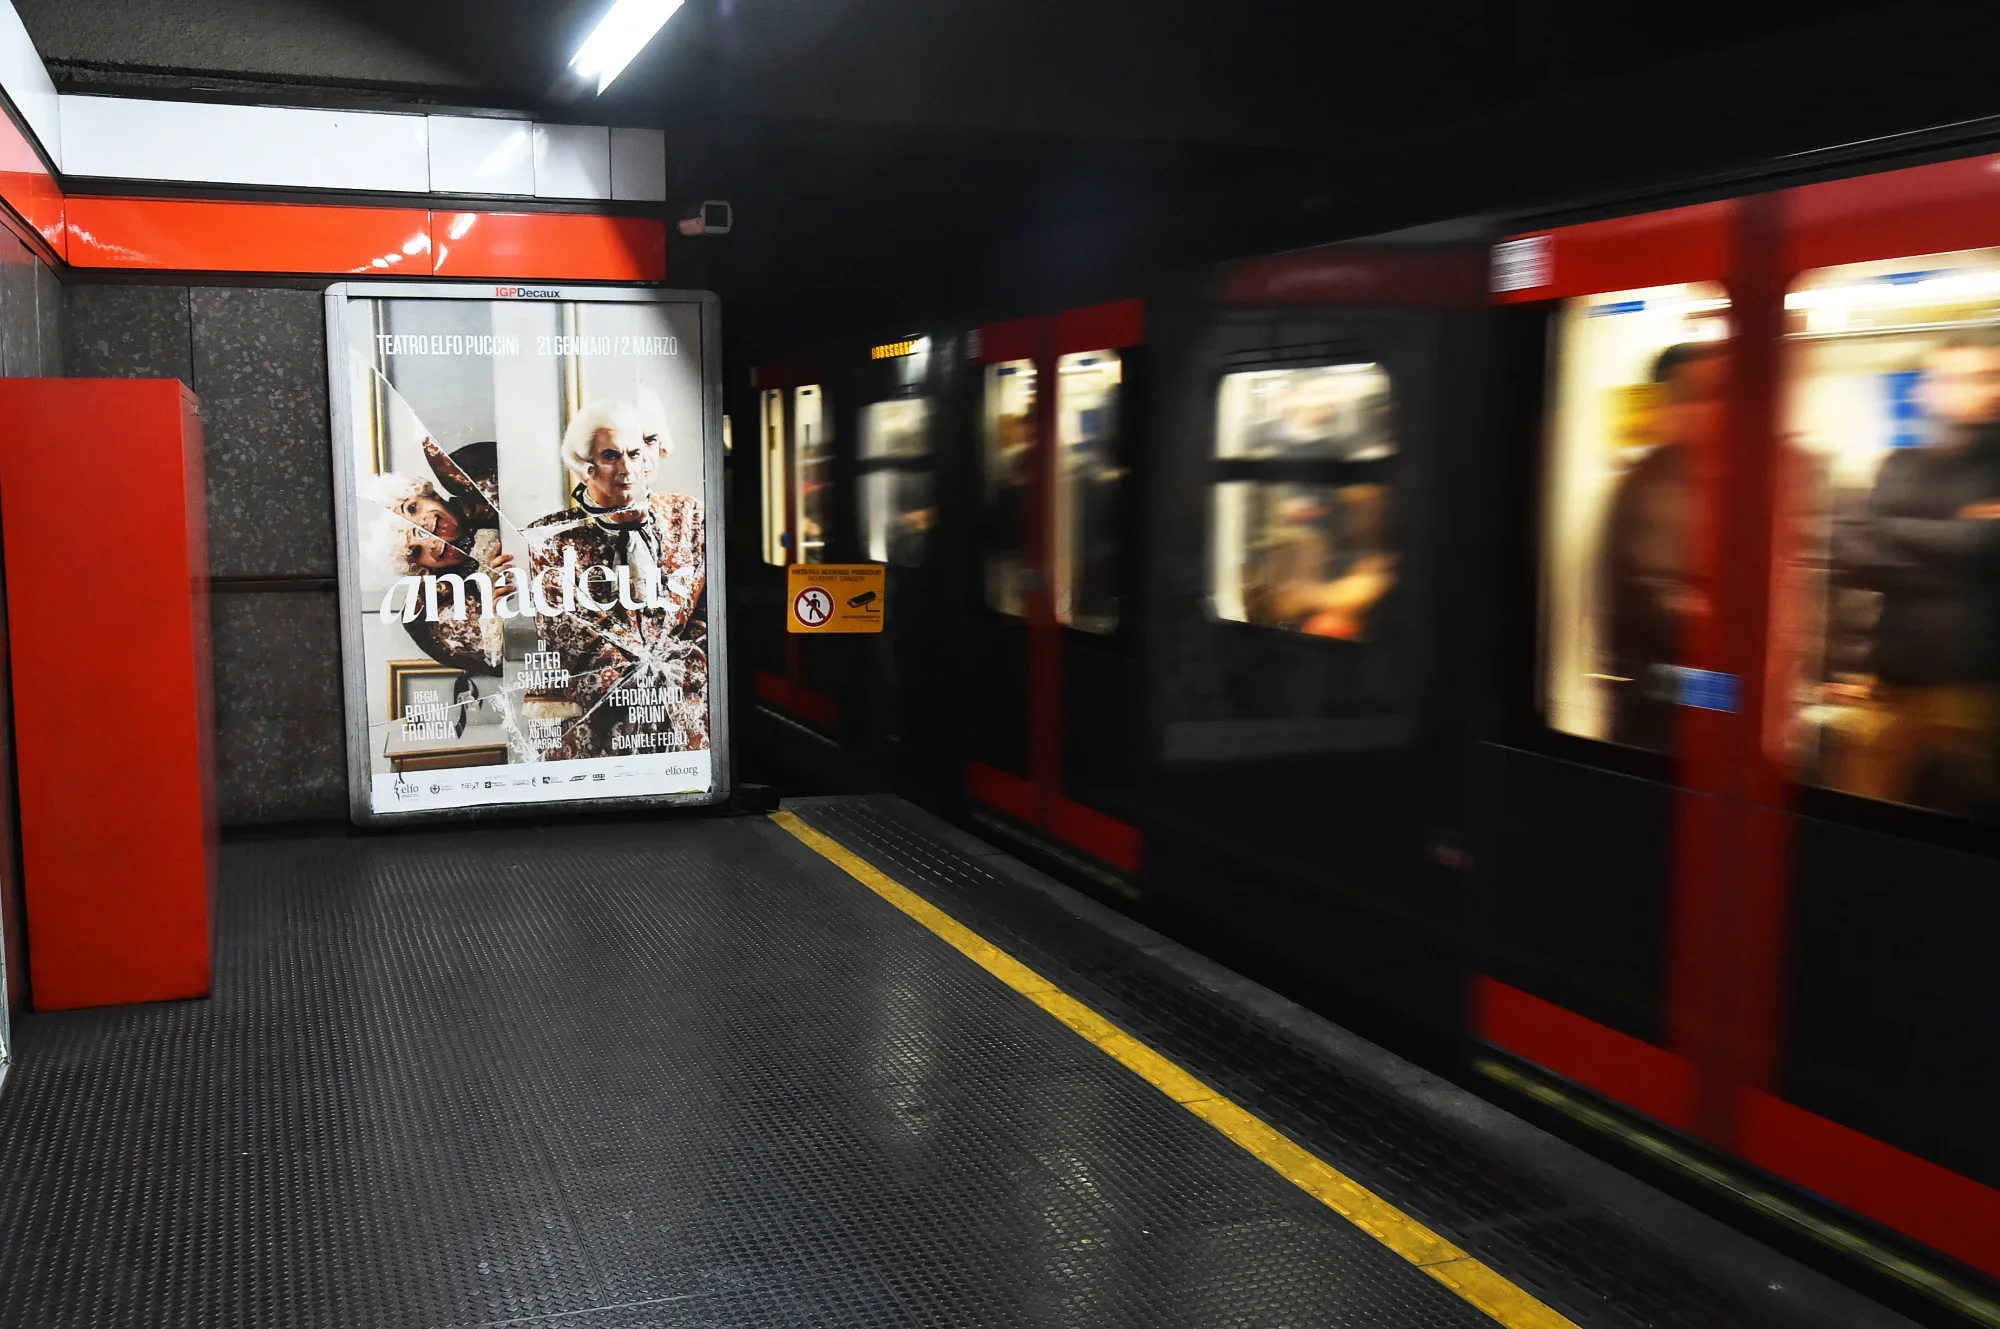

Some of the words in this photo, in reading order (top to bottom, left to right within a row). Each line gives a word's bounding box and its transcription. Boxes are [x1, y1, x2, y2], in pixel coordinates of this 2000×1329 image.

[495, 287, 560, 298] IGPDecaux
[376, 334, 428, 355] TEATRO
[430, 334, 463, 355] ELFO
[466, 334, 520, 356] PUCCINI
[537, 335, 550, 356] 21
[554, 335, 611, 356] GENNAIO
[621, 336, 630, 356] 2
[632, 336, 678, 356] MARZO
[379, 546, 695, 625] amadeus
[537, 639, 547, 652] DI
[524, 652, 561, 670] PETER
[517, 669, 571, 690] SHAFFER
[636, 675, 654, 688] CON
[413, 690, 439, 704] REGIA
[609, 686, 684, 707] FERDINANDO
[628, 705, 665, 724] BRUNI
[401, 720, 456, 742] FRONGIA
[529, 726, 562, 740] ANTONIO
[530, 737, 563, 750] MARRAS
[618, 733, 656, 749] DANIELE
[665, 764, 699, 777] elfo.org
[401, 784, 419, 794] elfo
